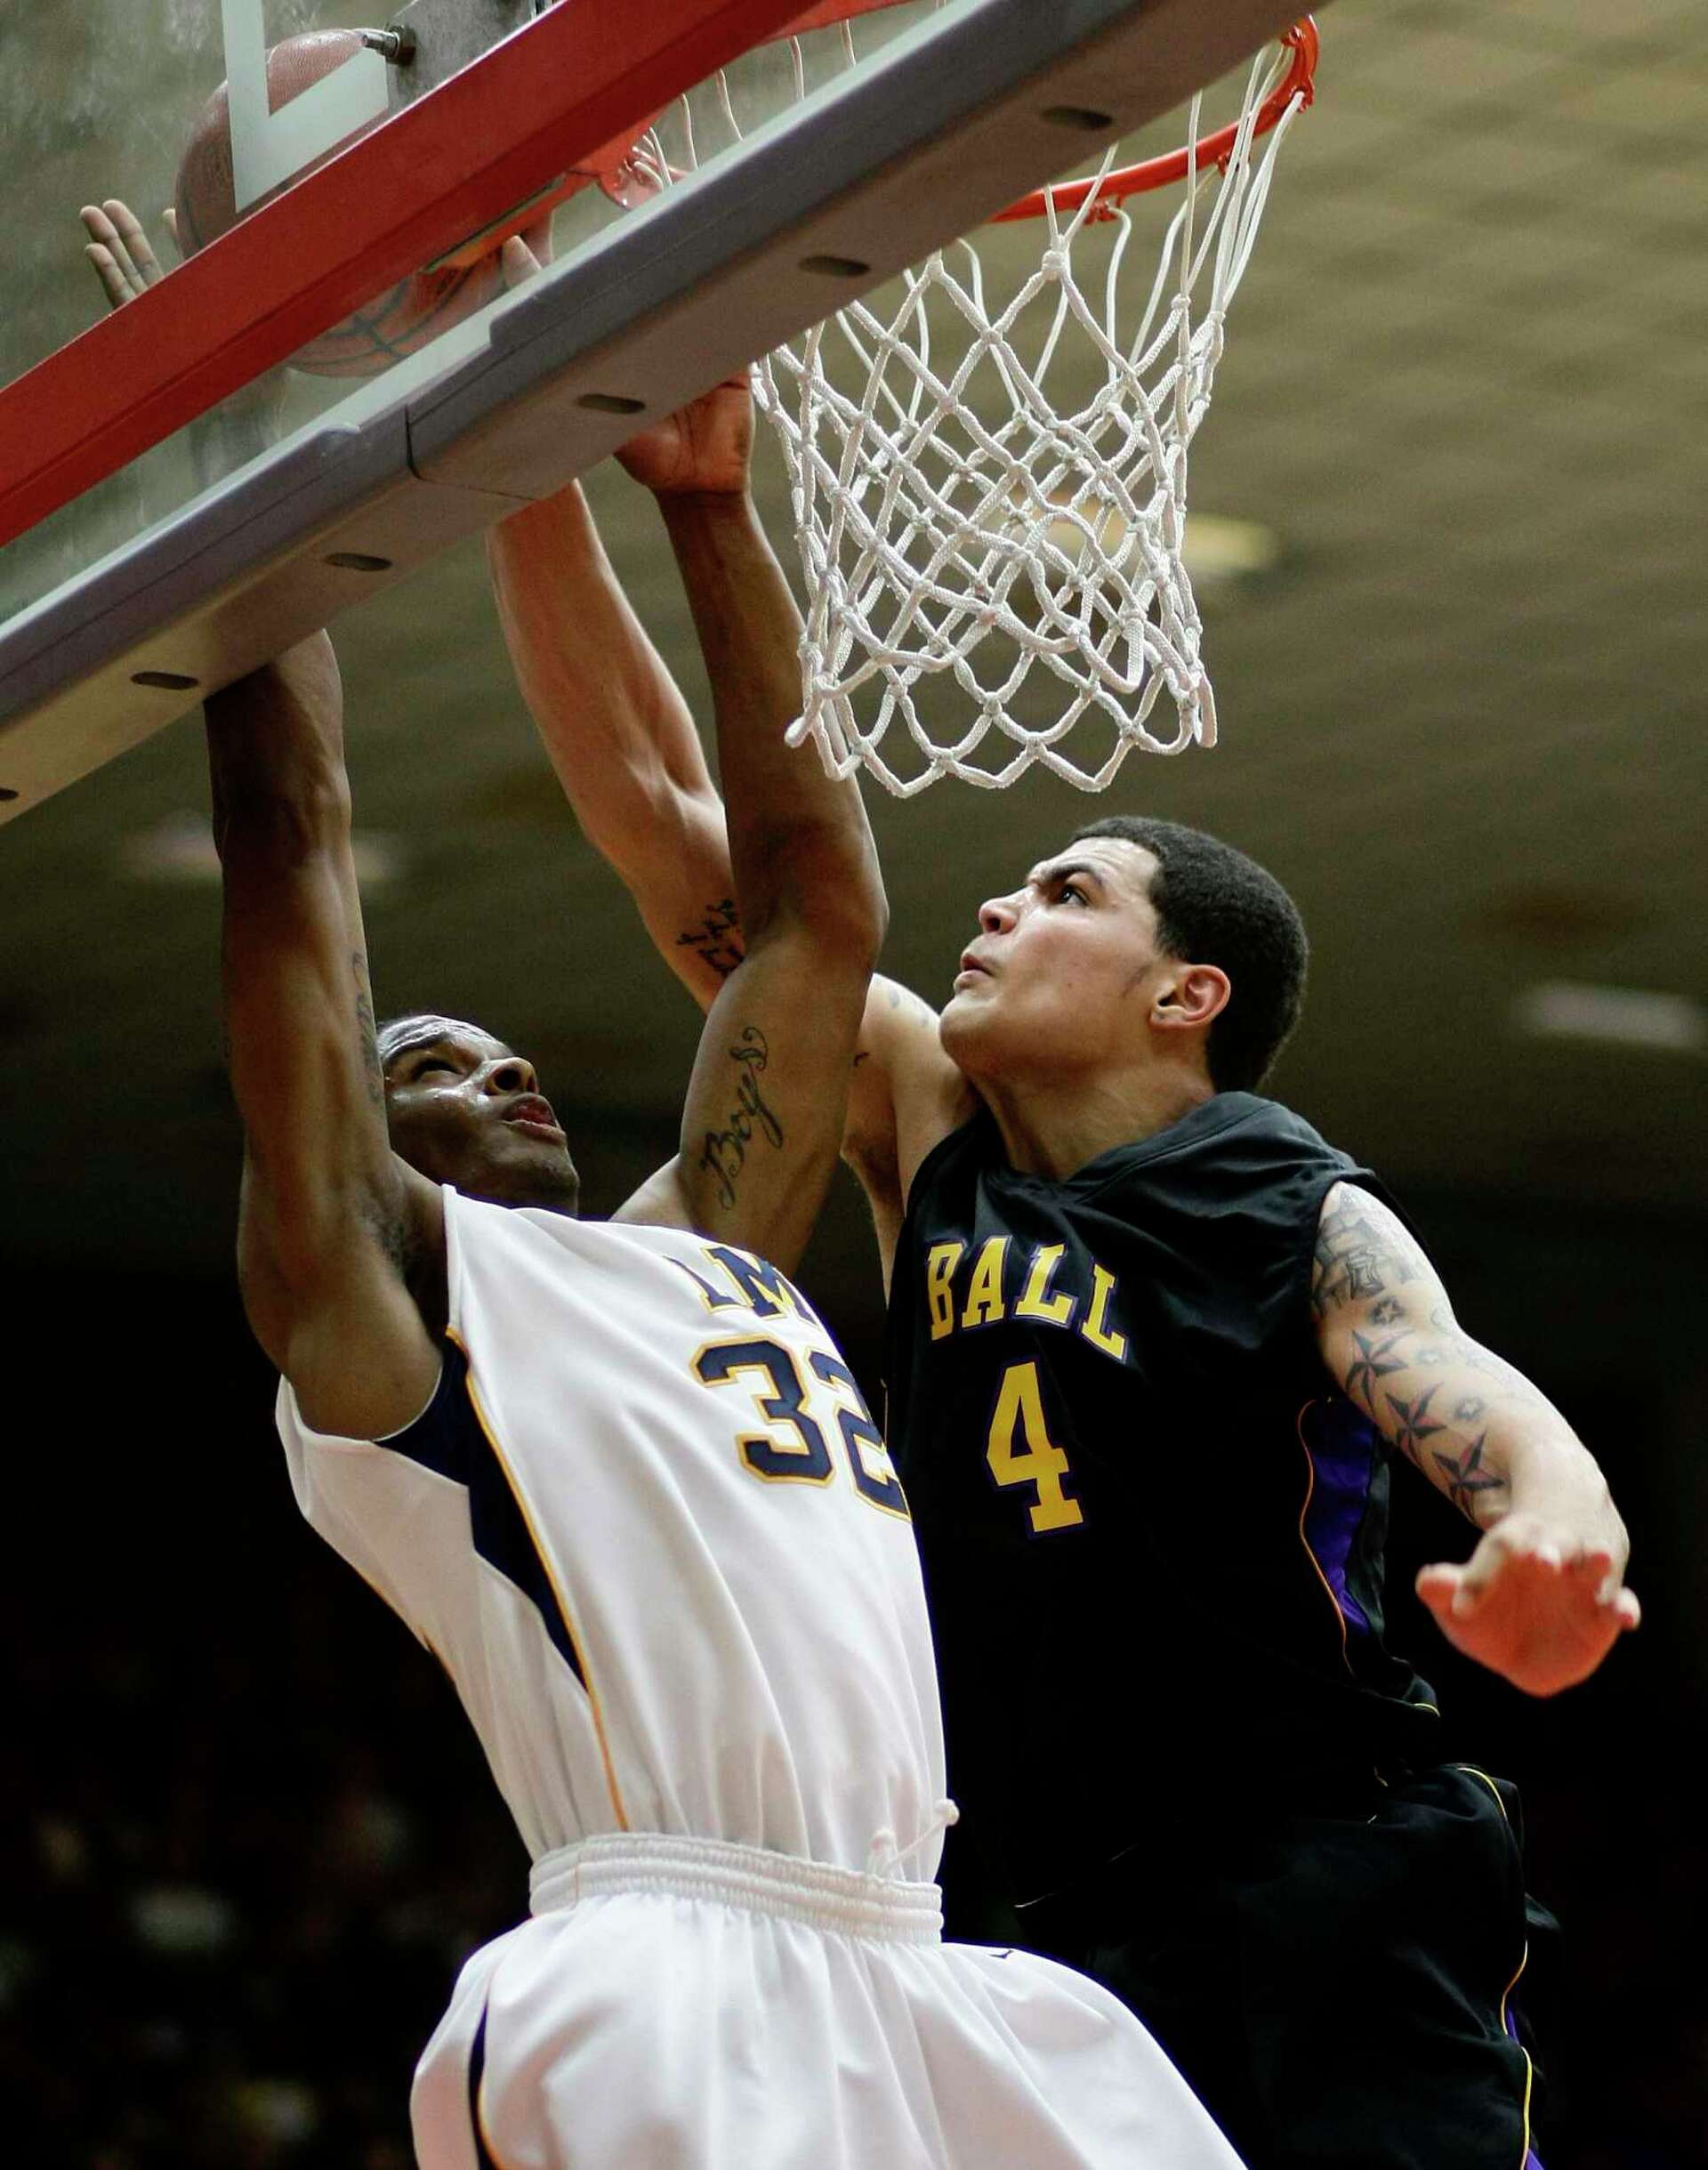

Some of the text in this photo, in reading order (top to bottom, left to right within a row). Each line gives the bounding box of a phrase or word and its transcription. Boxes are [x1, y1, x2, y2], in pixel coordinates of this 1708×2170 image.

[925, 1234, 1129, 1364] BALL
[689, 1334, 911, 1525] 32
[985, 1360, 1084, 1534] 4
